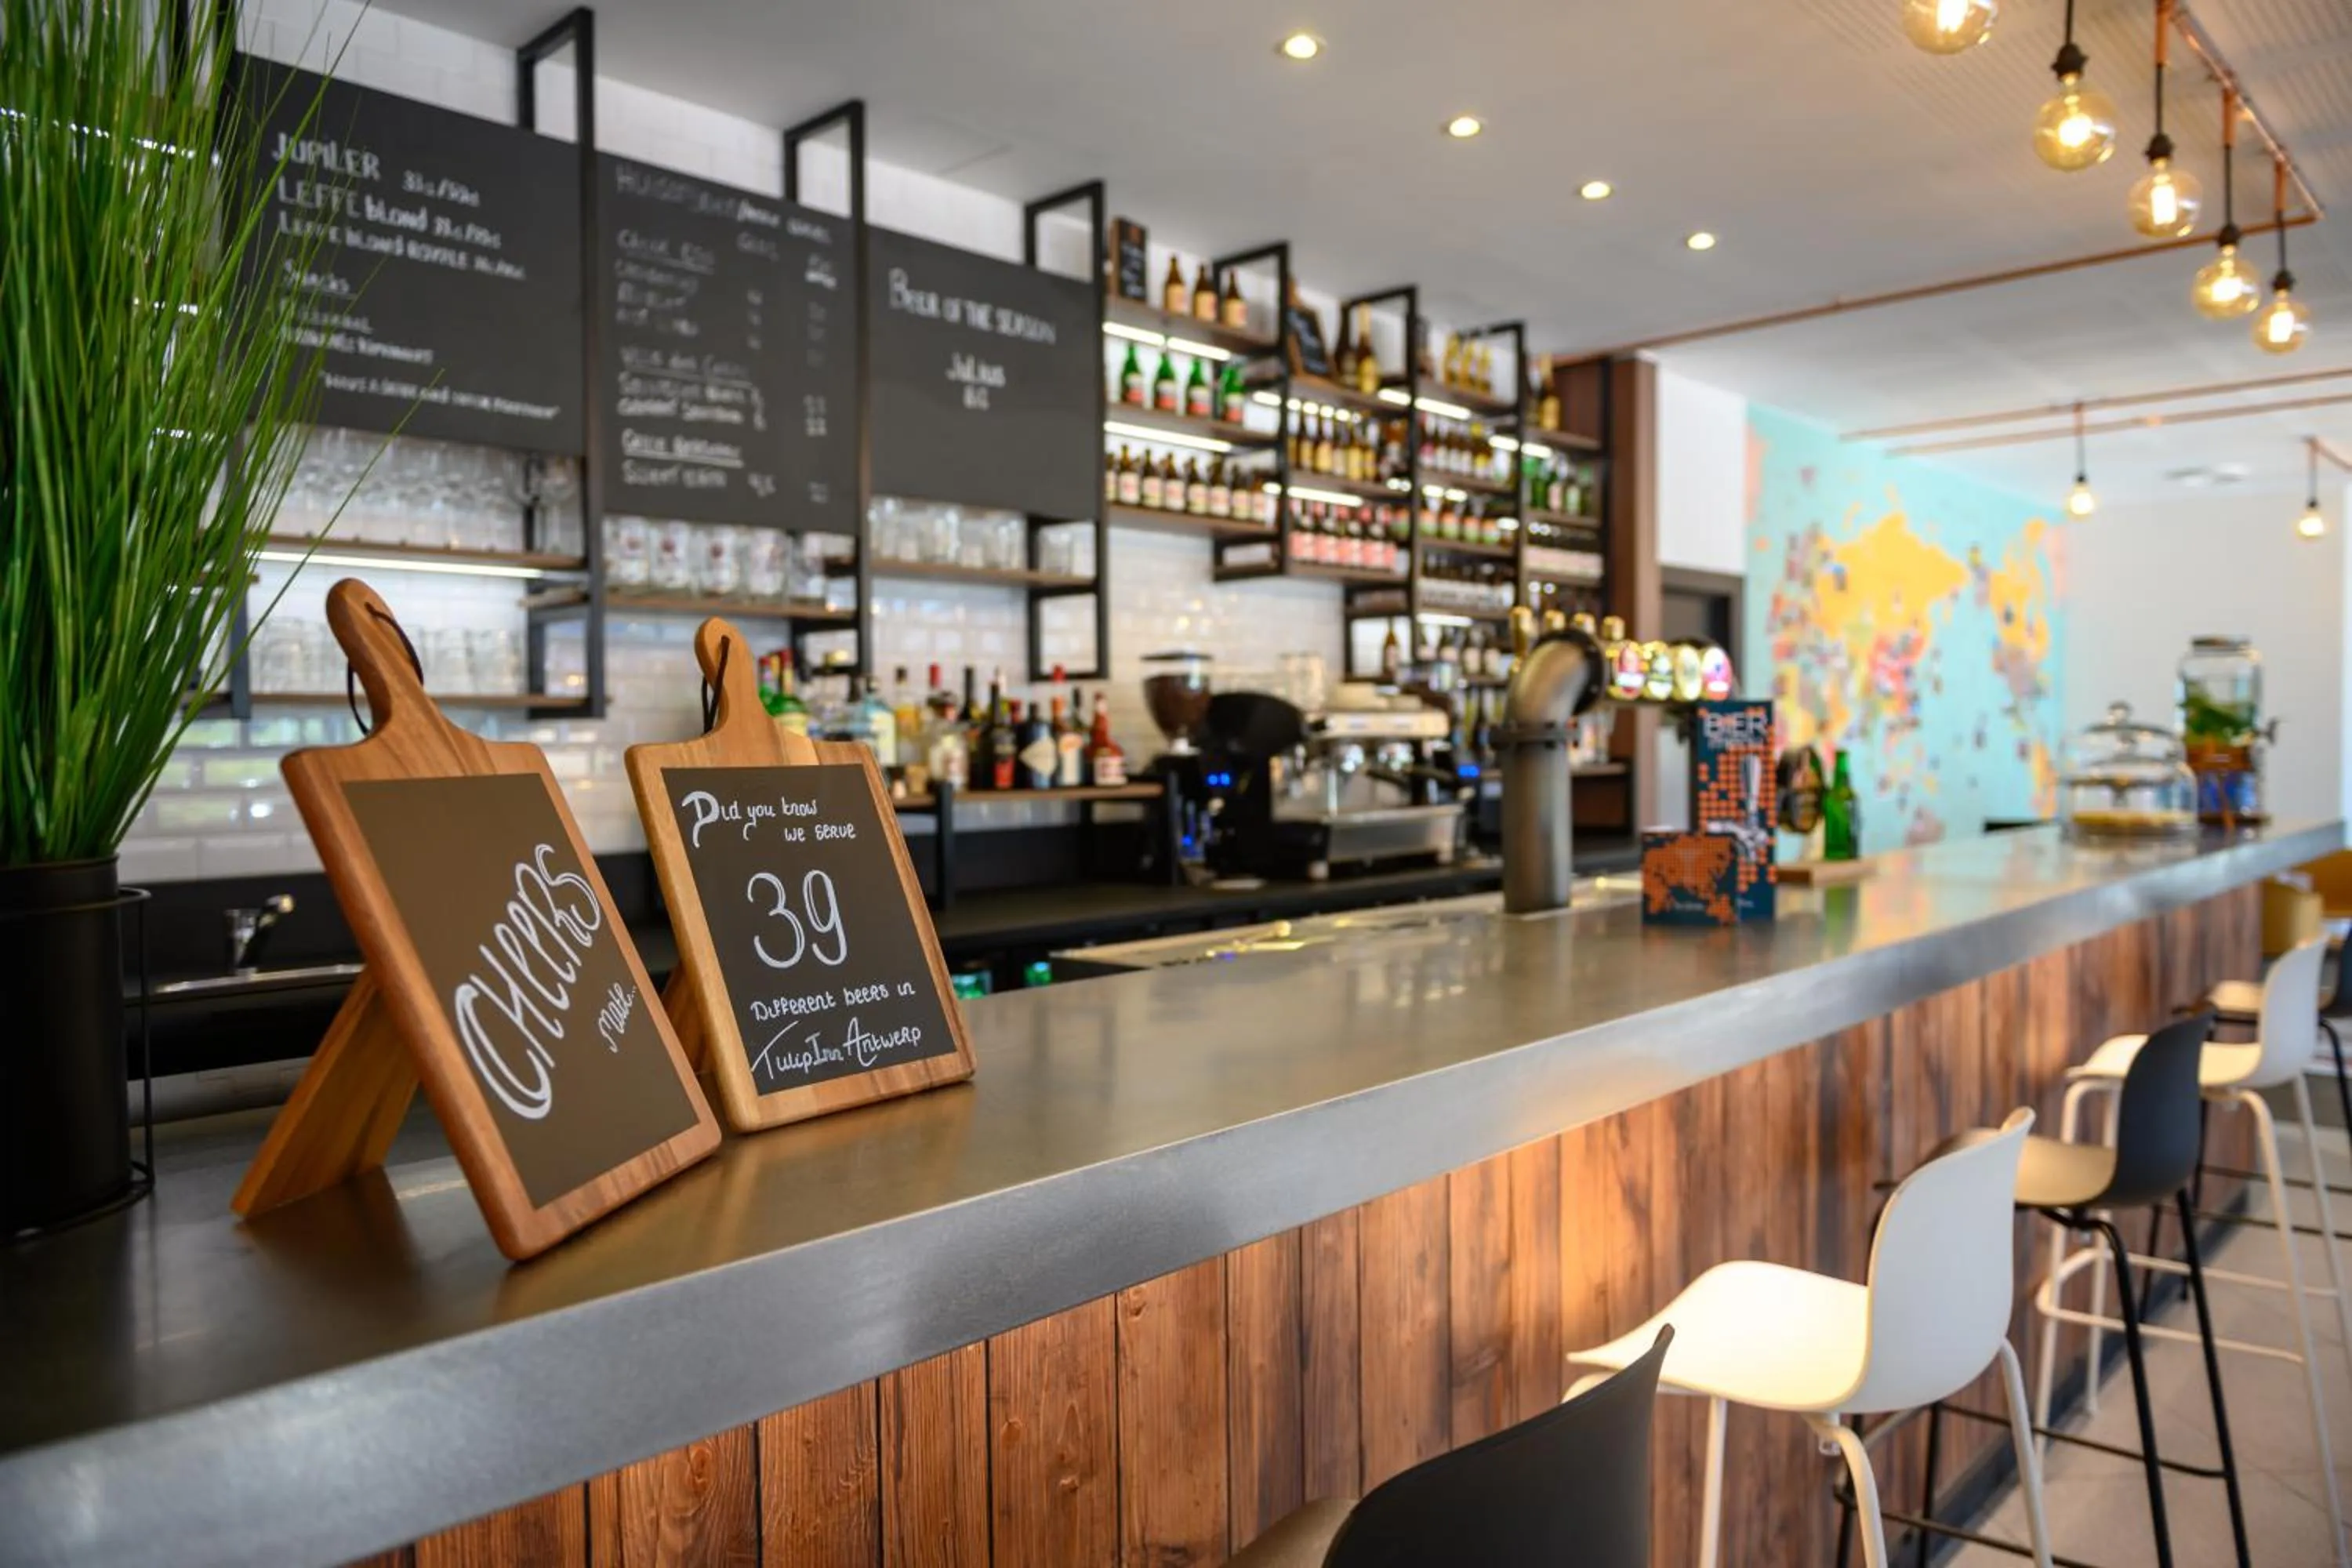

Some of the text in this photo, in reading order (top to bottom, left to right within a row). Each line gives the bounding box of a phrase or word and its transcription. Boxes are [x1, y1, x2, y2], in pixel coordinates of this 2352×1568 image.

[272, 132, 381, 180] JUPILER
[682, 790, 818, 848] Did you know
[747, 869, 848, 969] 39
[898, 982, 916, 996] in
